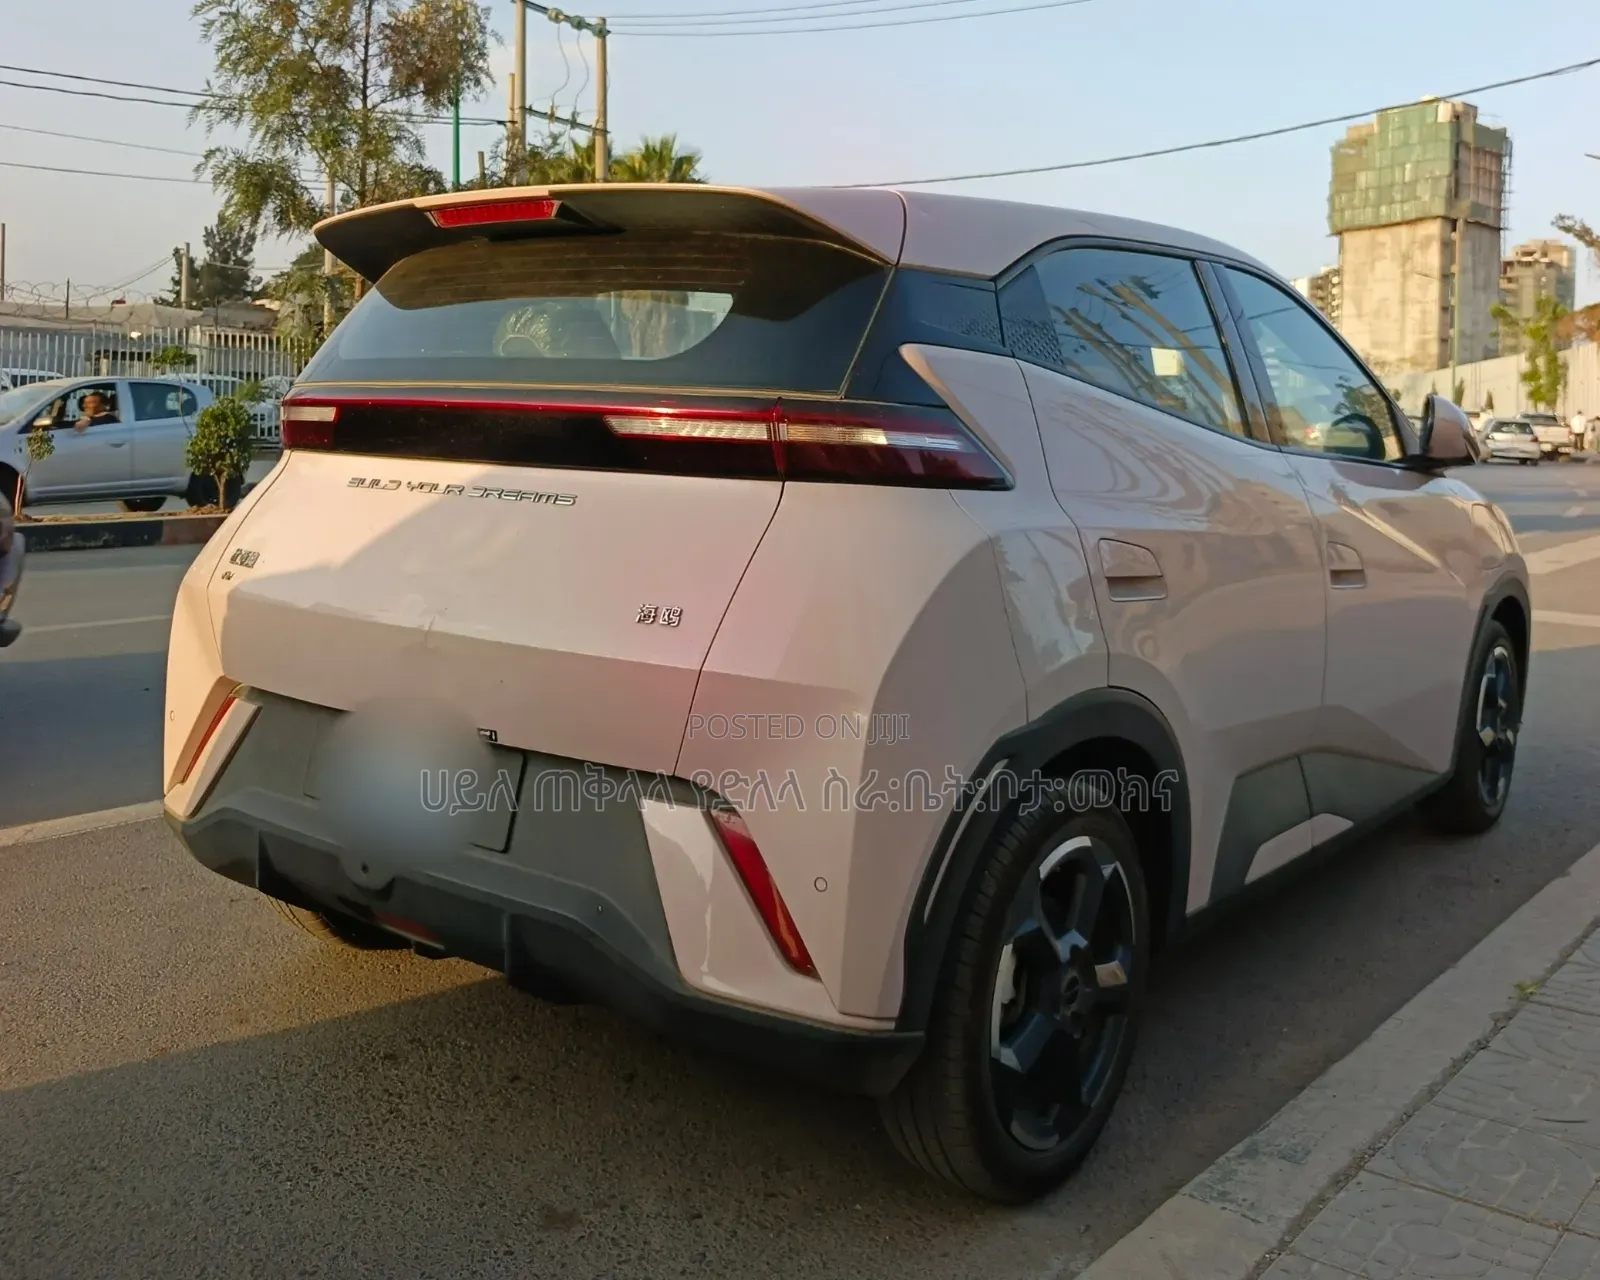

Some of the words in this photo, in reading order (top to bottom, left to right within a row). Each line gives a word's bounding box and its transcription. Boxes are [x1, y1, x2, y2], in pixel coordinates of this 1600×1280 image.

[347, 476, 402, 491] BUILD
[406, 480, 466, 497] YOUR
[467, 485, 579, 507] DREAMS
[635, 603, 683, 628] 海鸥
